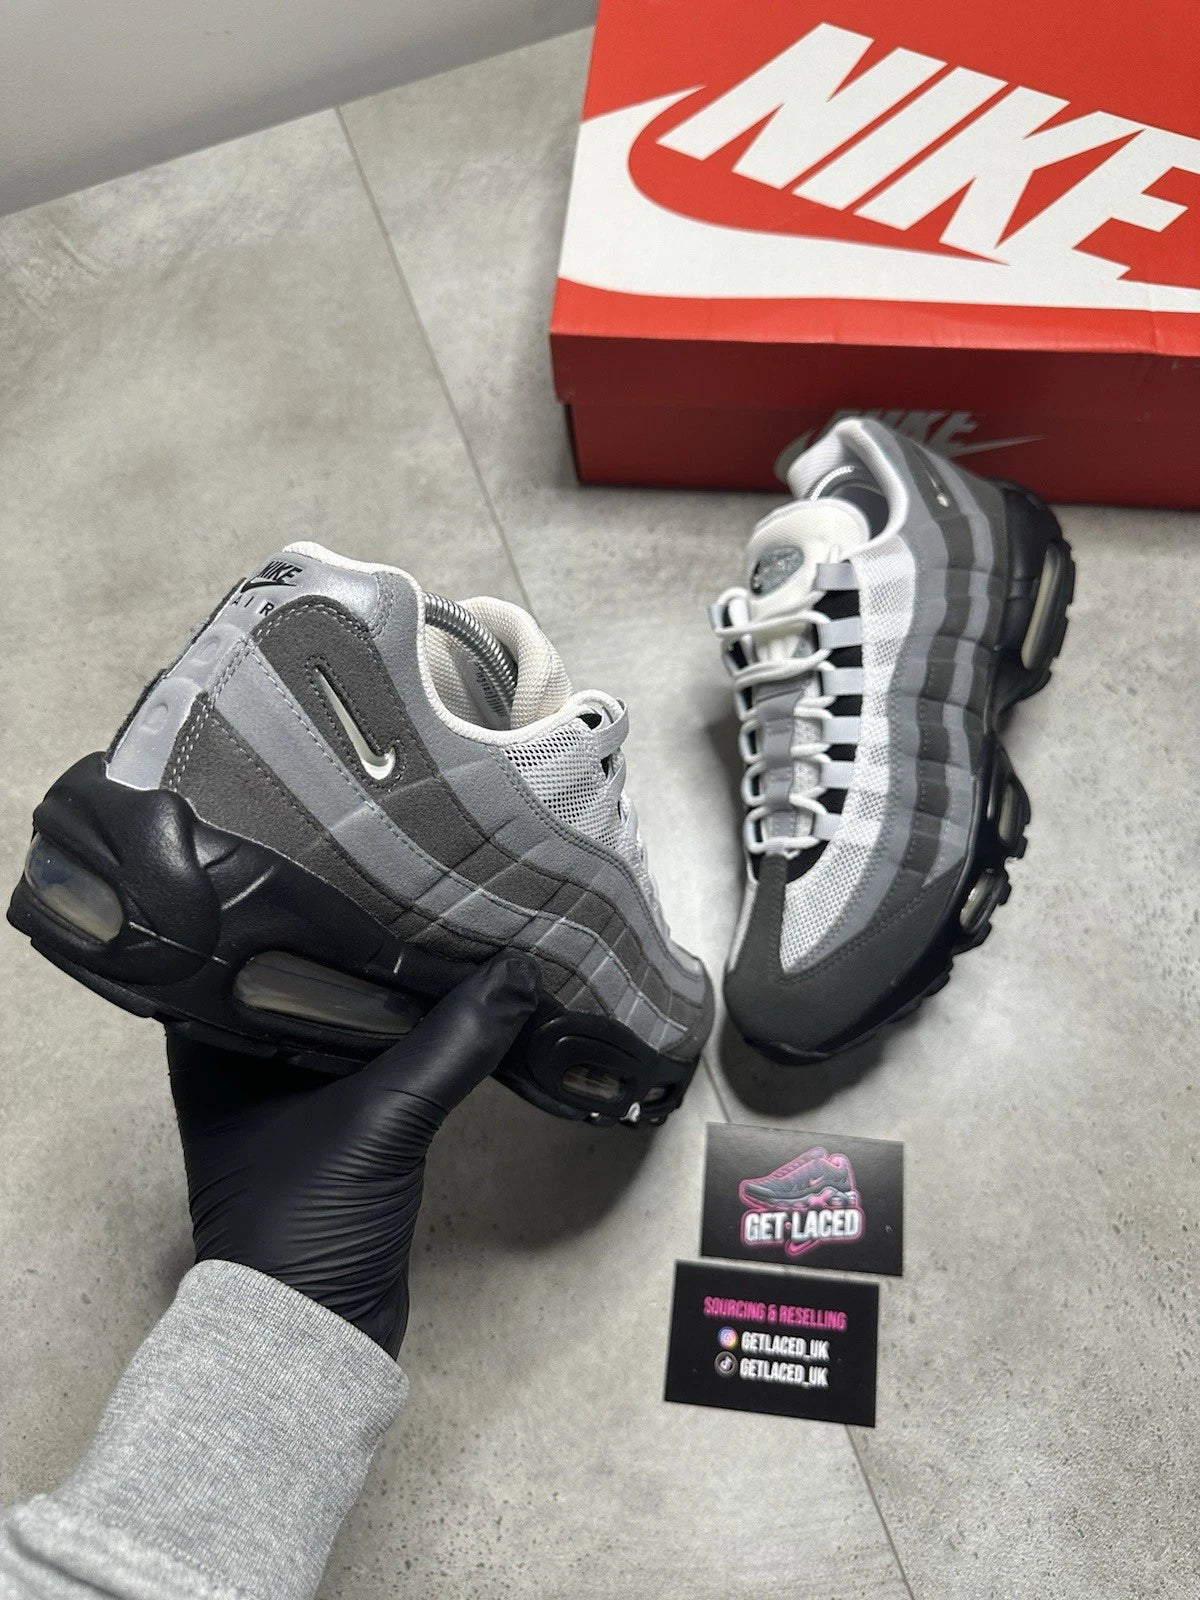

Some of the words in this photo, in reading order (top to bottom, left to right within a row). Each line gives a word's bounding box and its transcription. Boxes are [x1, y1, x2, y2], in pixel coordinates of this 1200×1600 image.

[656, 22, 1200, 283] NIKE
[258, 560, 303, 584] NIKE
[232, 595, 275, 616] AIR
[745, 1213, 786, 1240] GET
[792, 1209, 860, 1240] LACED
[704, 1296, 766, 1321] SOURCING
[779, 1305, 847, 1330] RESELLING
[741, 1331, 830, 1361] GETLACED_UK
[739, 1357, 830, 1388] GETLACED_UK
